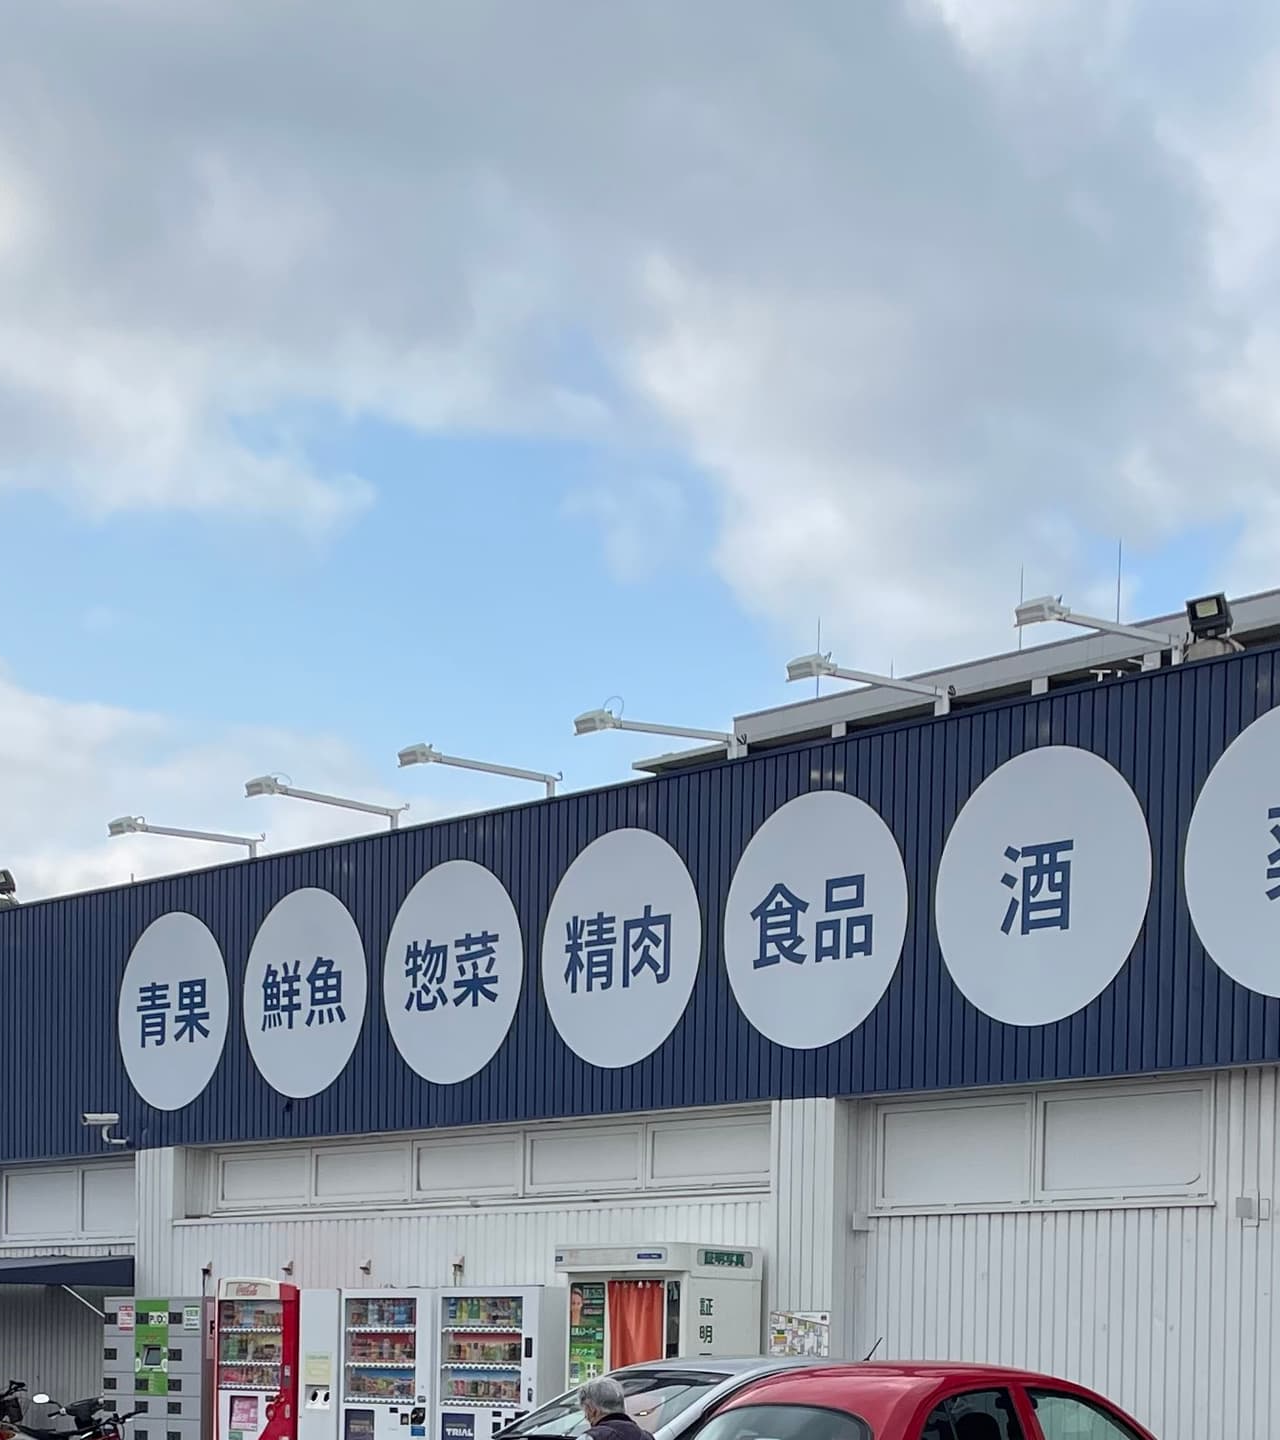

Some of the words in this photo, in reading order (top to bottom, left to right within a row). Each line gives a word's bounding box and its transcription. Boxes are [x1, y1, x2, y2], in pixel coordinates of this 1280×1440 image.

[749, 872, 876, 971] 食品
[998, 838, 1076, 937] 酒
[403, 929, 500, 1013] 惣菜
[563, 903, 674, 996] 精肉
[135, 978, 211, 1049] 青果
[260, 956, 347, 1033] 鮮魚
[704, 1251, 745, 1267] 証明写真
[699, 1297, 714, 1356] 証明
[445, 1427, 474, 1437] TRIAL
